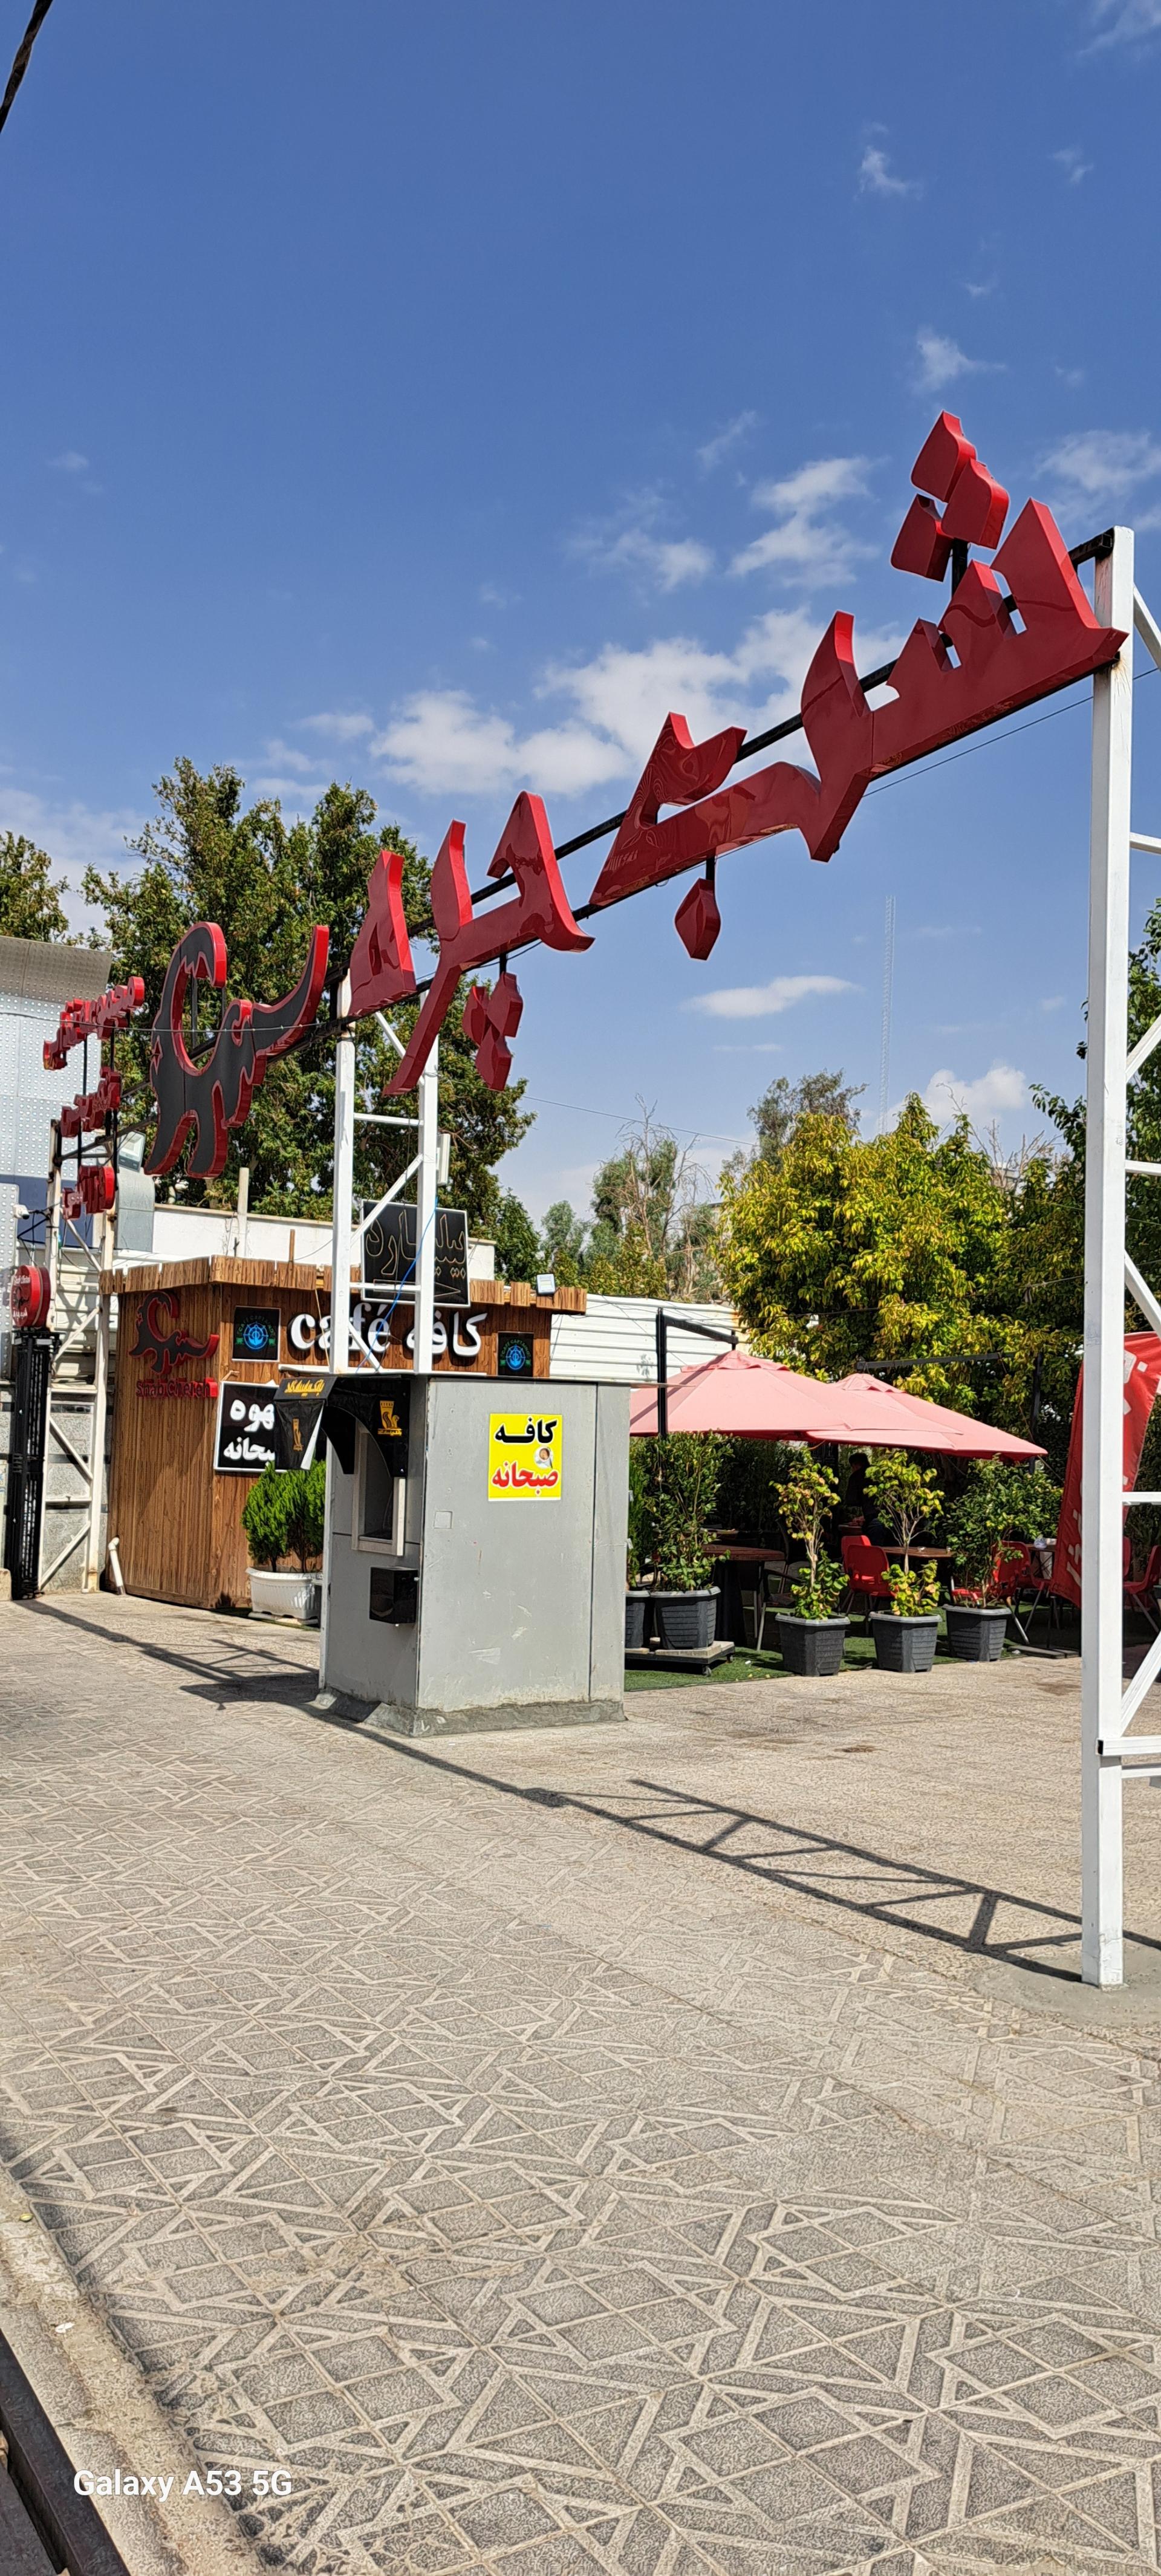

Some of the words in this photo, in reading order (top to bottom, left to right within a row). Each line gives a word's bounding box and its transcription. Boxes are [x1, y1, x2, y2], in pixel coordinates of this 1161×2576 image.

[365, 1209, 467, 1279] بیلارد
[136, 1379, 166, 1398] Shab
[167, 1377, 218, 1399] Chereh
[230, 1399, 275, 1432] هوه
[495, 1417, 558, 1443] کافه
[223, 1437, 275, 1467] بحانه
[492, 1462, 558, 1494] صبحانه
